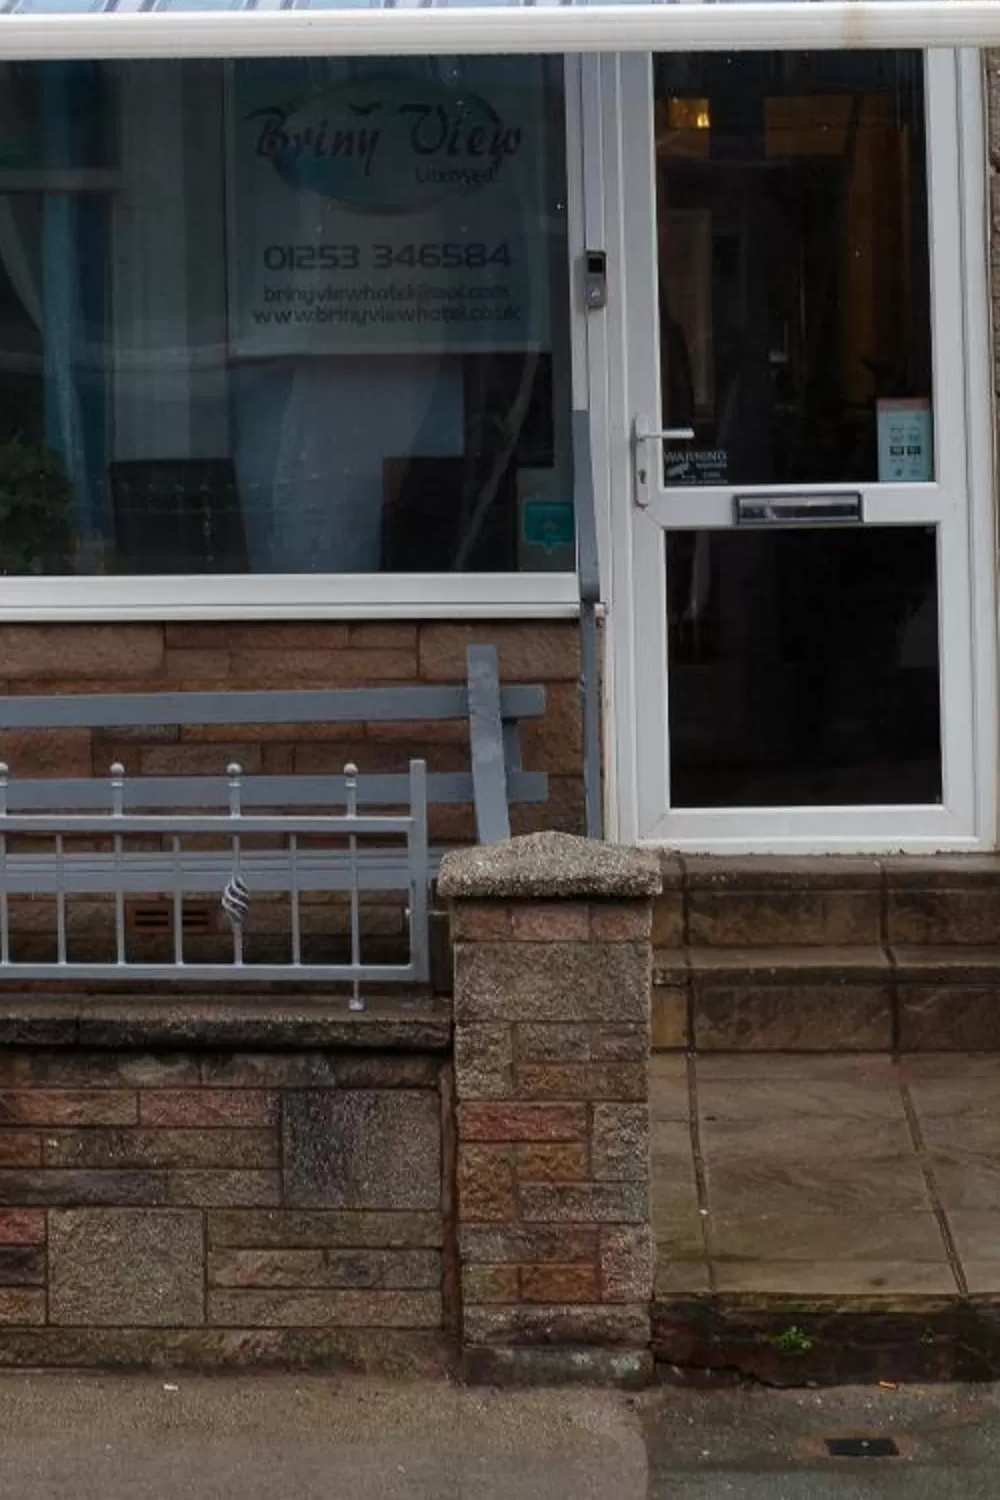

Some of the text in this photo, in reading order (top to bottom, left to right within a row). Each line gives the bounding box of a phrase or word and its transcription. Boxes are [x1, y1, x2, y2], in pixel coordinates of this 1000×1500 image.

[243, 103, 522, 178] Briny View
[263, 242, 513, 271] 01253 346584
